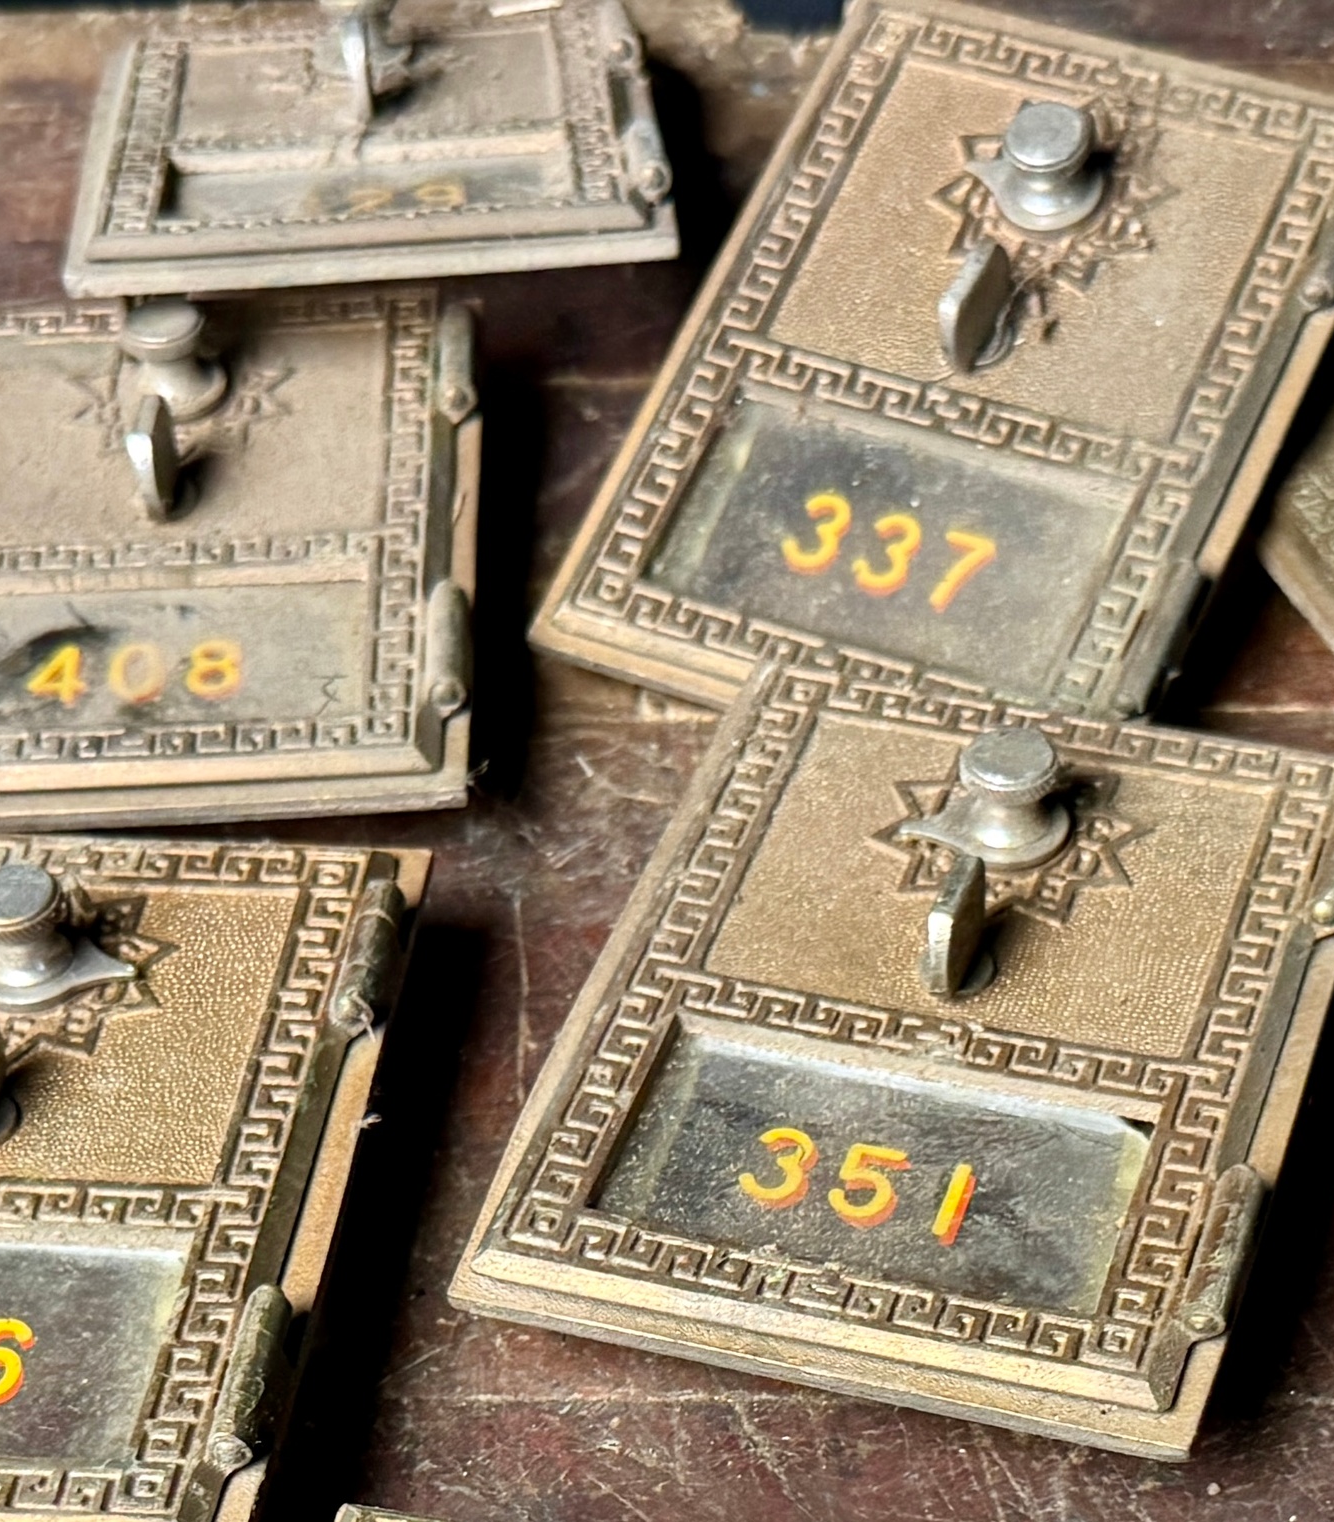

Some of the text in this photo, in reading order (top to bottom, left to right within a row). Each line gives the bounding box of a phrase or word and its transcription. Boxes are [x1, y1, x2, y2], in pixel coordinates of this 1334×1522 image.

[780, 494, 997, 613] 337
[26, 642, 242, 708] 408
[738, 1127, 978, 1246] 351
